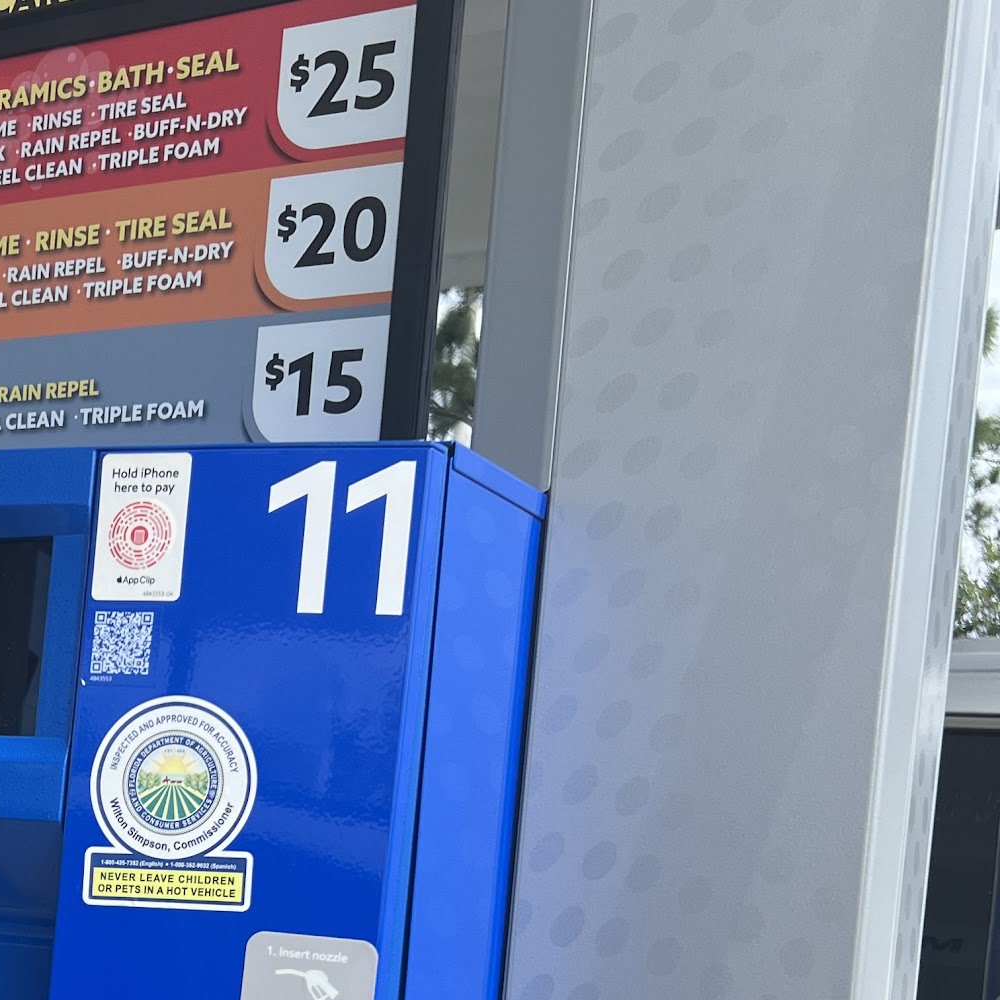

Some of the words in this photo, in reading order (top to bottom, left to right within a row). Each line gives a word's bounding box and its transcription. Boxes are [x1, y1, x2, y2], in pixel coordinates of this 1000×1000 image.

[97, 61, 164, 94] BATH
[175, 48, 240, 80] SEAL
[290, 40, 396, 118] $25
[20, 137, 64, 159] RAIN
[68, 126, 121, 151] REPEL
[133, 106, 248, 141] BUFF-N-DRY
[31, 109, 82, 132] RINSE
[98, 95, 136, 121] TIRE
[140, 91, 186, 113] SEAL
[24, 158, 83, 182] CLEAN
[98, 145, 158, 171] TRIPLE
[163, 137, 220, 162] FOAM
[35, 223, 100, 252] RINSE
[115, 215, 166, 242] TIRE
[172, 207, 232, 236] SEAL
[277, 196, 387, 268] $20
[7, 263, 50, 283] RAIN
[54, 256, 105, 279] REPEL
[121, 241, 234, 270] BUFF-N-DRY
[11, 285, 68, 307] CLEAN
[83, 277, 143, 298] TRIPLE
[146, 270, 202, 292] FOAM
[45, 379, 99, 399] REPEL
[265, 348, 364, 417] $15
[5, 410, 65, 431] CLEAN
[80, 405, 142, 425] TRIPLE
[146, 399, 204, 419] FOAM
[112, 467, 138, 479] Hold
[141, 467, 179, 479] iPhone
[114, 481, 138, 493] here
[141, 482, 153, 493] to
[155, 484, 175, 495] pay
[267, 460, 417, 616] 11
[122, 575, 139, 585] App
[140, 575, 156, 585] Clip
[109, 728, 139, 770] INSPECTED
[138, 720, 155, 734] AND
[155, 714, 199, 726] APPROVED
[199, 720, 214, 735] FOR
[212, 732, 239, 773] ACCURACY
[129, 758, 143, 787] FLORIDA
[142, 736, 184, 759] DEPARTMENT
[185, 738, 195, 747] OF
[195, 742, 218, 790] AGRICULTURE
[110, 797, 127, 830] Wilton
[127, 827, 170, 853] Simpson,
[174, 801, 234, 851] Commissioner
[131, 797, 142, 813] AND
[141, 811, 180, 829] CONSUMER
[182, 798, 212, 827] SERVICES
[98, 884, 112, 893] OR
[115, 885, 141, 894] PETS
[144, 886, 154, 894] IN
[156, 886, 164, 894] A
[166, 887, 188, 896] HOT
[190, 887, 236, 898] VEHICLE
[100, 872, 136, 882] NEVER
[139, 873, 174, 883] LEAVE
[178, 874, 235, 886] CHILDREN
[267, 945, 277, 957] 1.
[279, 947, 311, 960] Insert
[312, 951, 348, 964] nozzle
